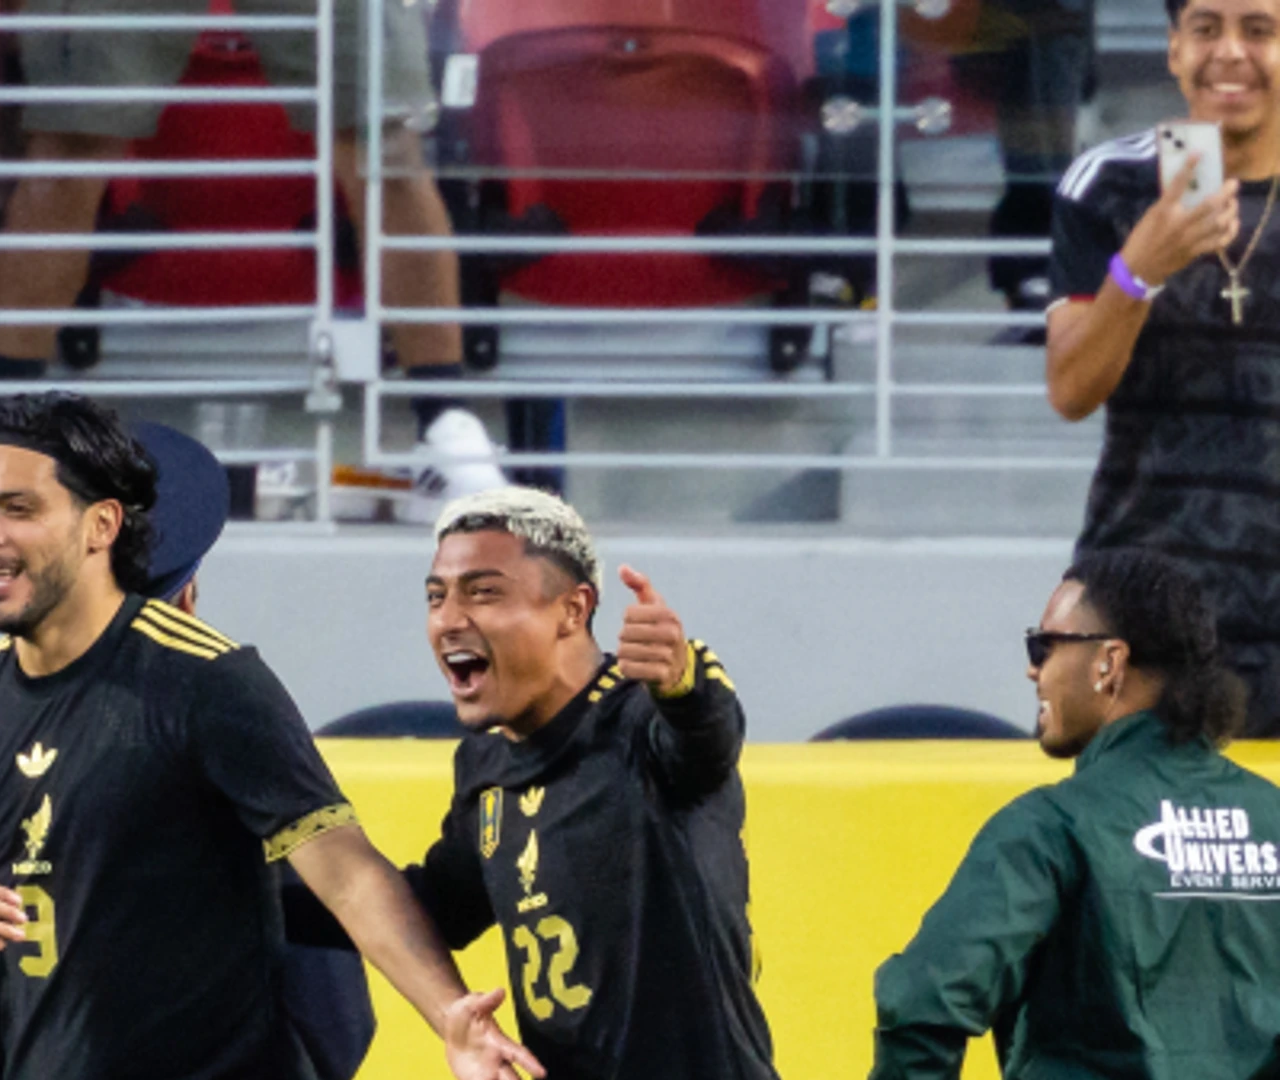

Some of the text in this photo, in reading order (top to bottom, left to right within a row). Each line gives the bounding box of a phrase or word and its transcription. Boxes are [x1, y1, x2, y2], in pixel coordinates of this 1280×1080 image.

[1161, 799, 1250, 840] ALLIED
[14, 883, 58, 979] 9
[512, 914, 593, 1022] 22
